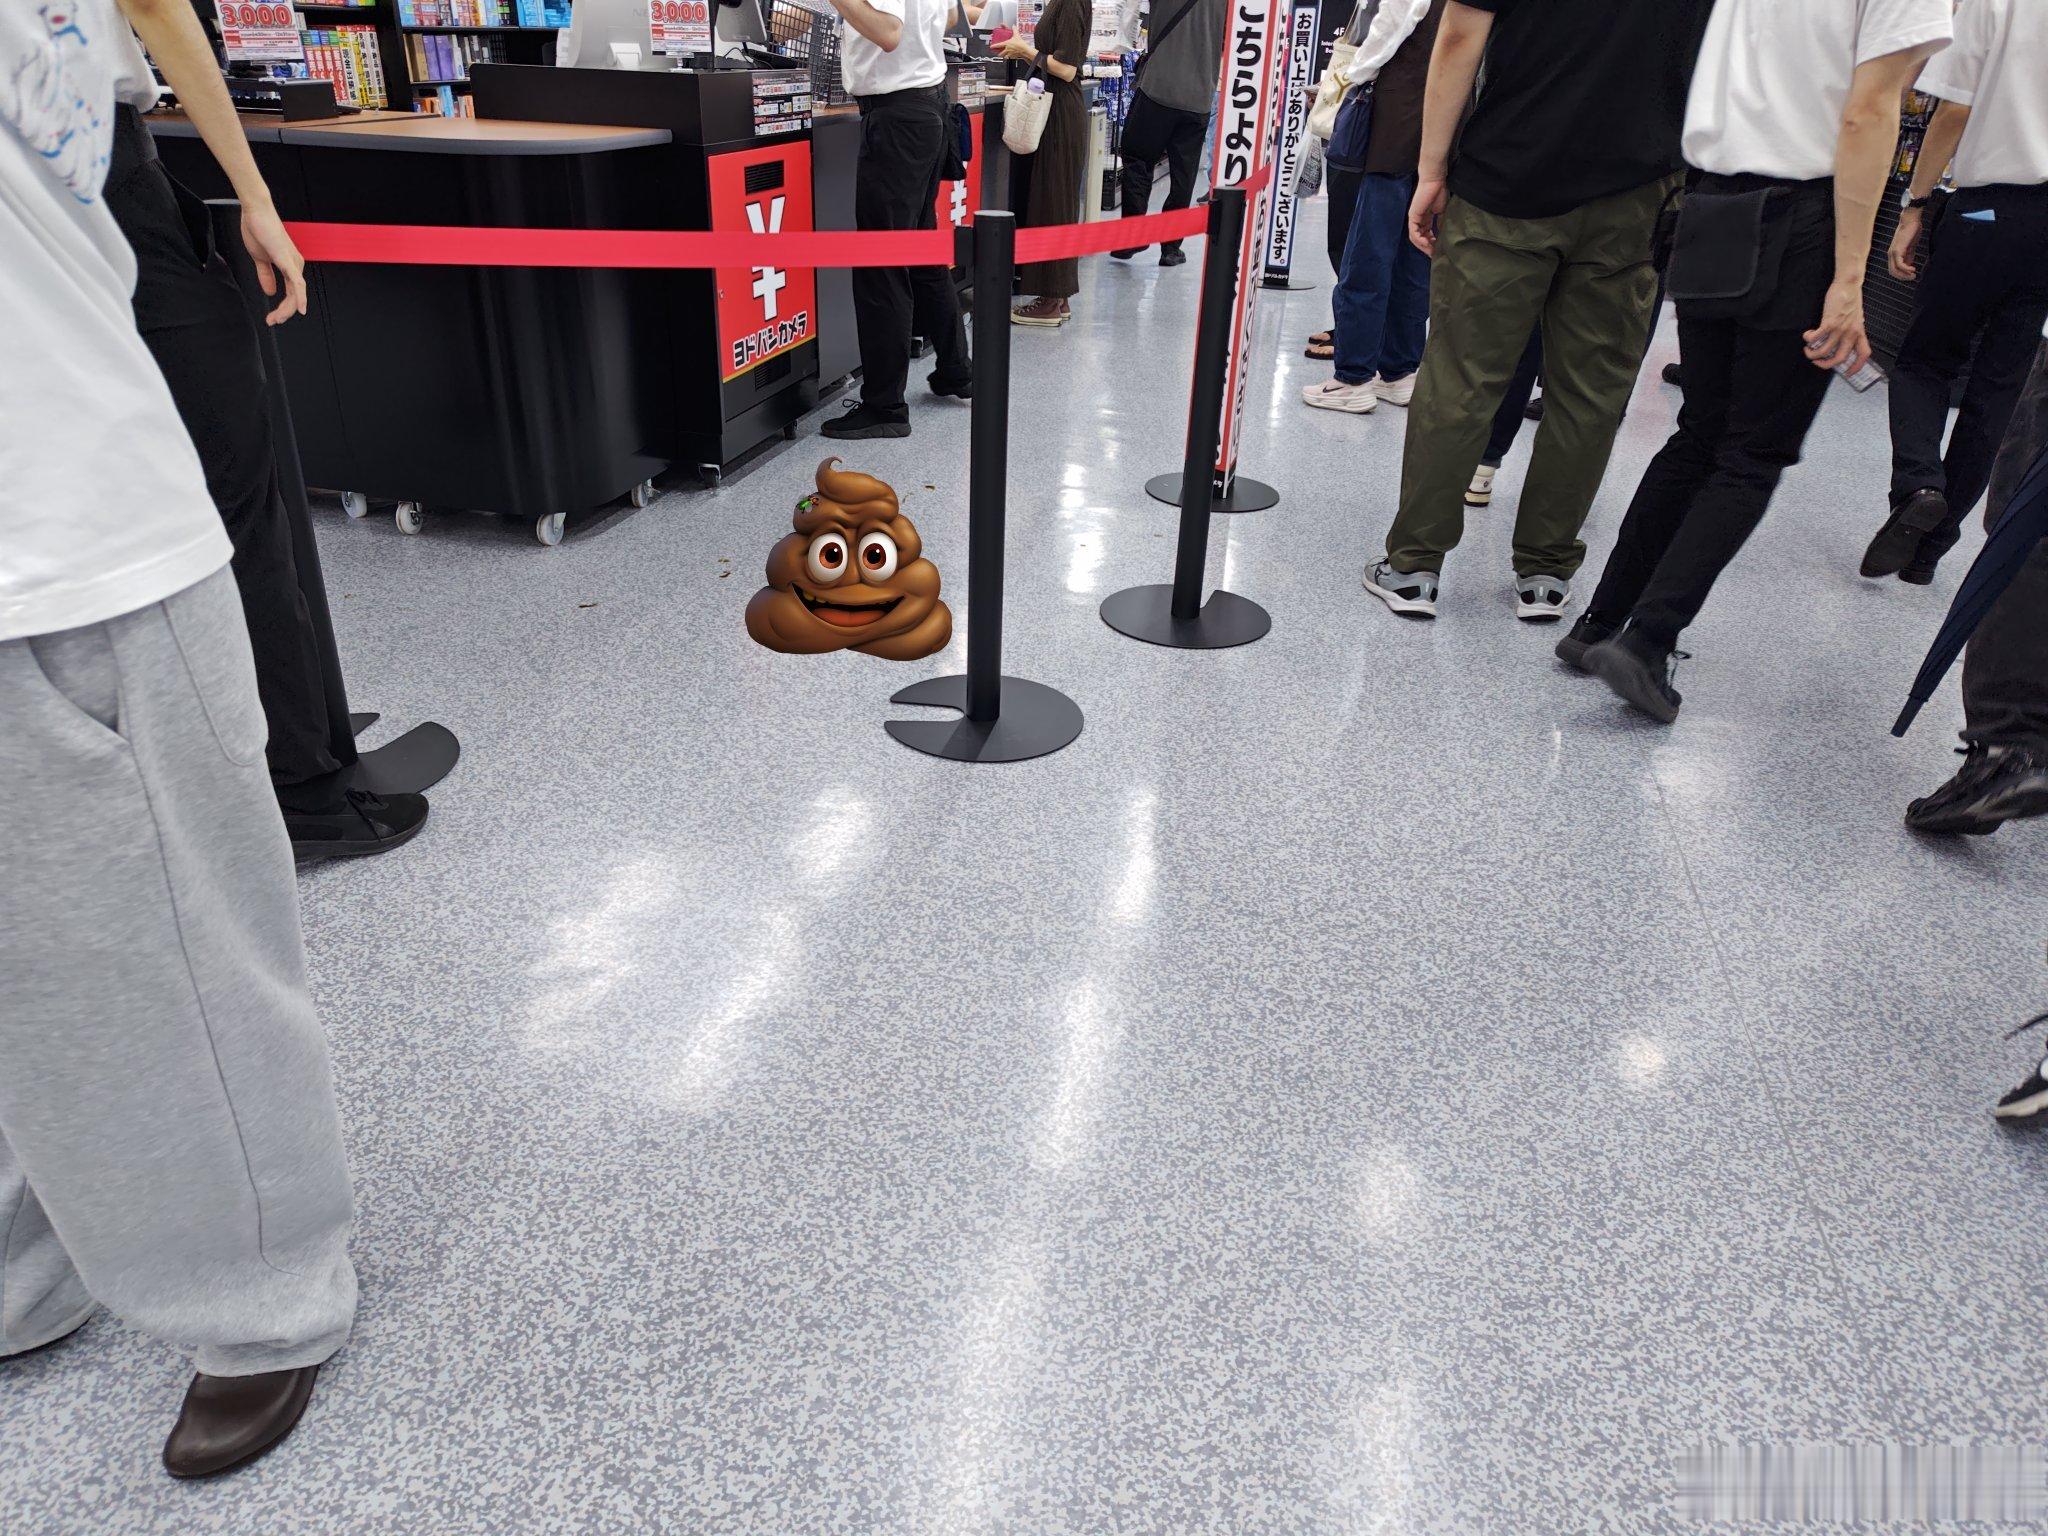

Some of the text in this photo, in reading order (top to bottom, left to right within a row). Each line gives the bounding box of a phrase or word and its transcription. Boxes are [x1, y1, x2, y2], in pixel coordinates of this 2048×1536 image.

[733, 310, 808, 370] ヨドバシカメラ
